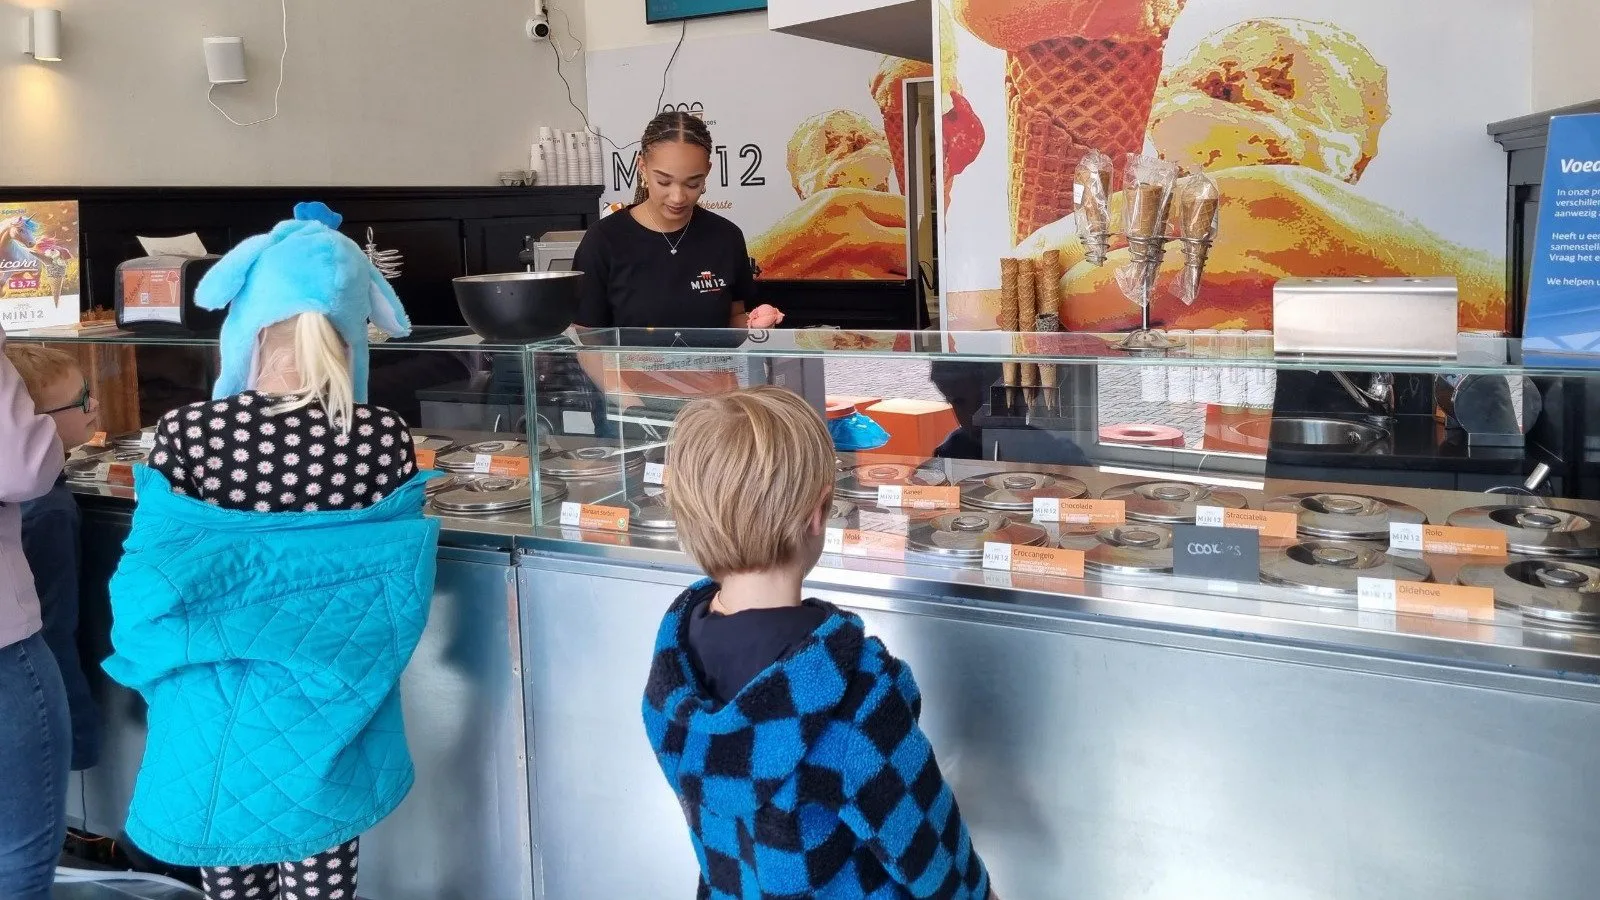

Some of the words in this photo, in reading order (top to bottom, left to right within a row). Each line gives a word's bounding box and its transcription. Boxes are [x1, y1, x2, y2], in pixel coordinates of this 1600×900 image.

[701, 200, 733, 210] kkerste
[1554, 209, 1597, 219] aanwezig
[1552, 232, 1577, 240] Heeft
[1549, 254, 1576, 263] Vraag
[17, 280, 37, 288] 3,75
[1546, 278, 1561, 286] We
[1562, 278, 1594, 287] helpen
[1060, 502, 1093, 510] Chocolade
[1226, 511, 1267, 522] Stracciatella
[1425, 528, 1443, 537] Rolo
[1013, 549, 1055, 560] Croccangelo
[1399, 585, 1441, 597] Oldehove
